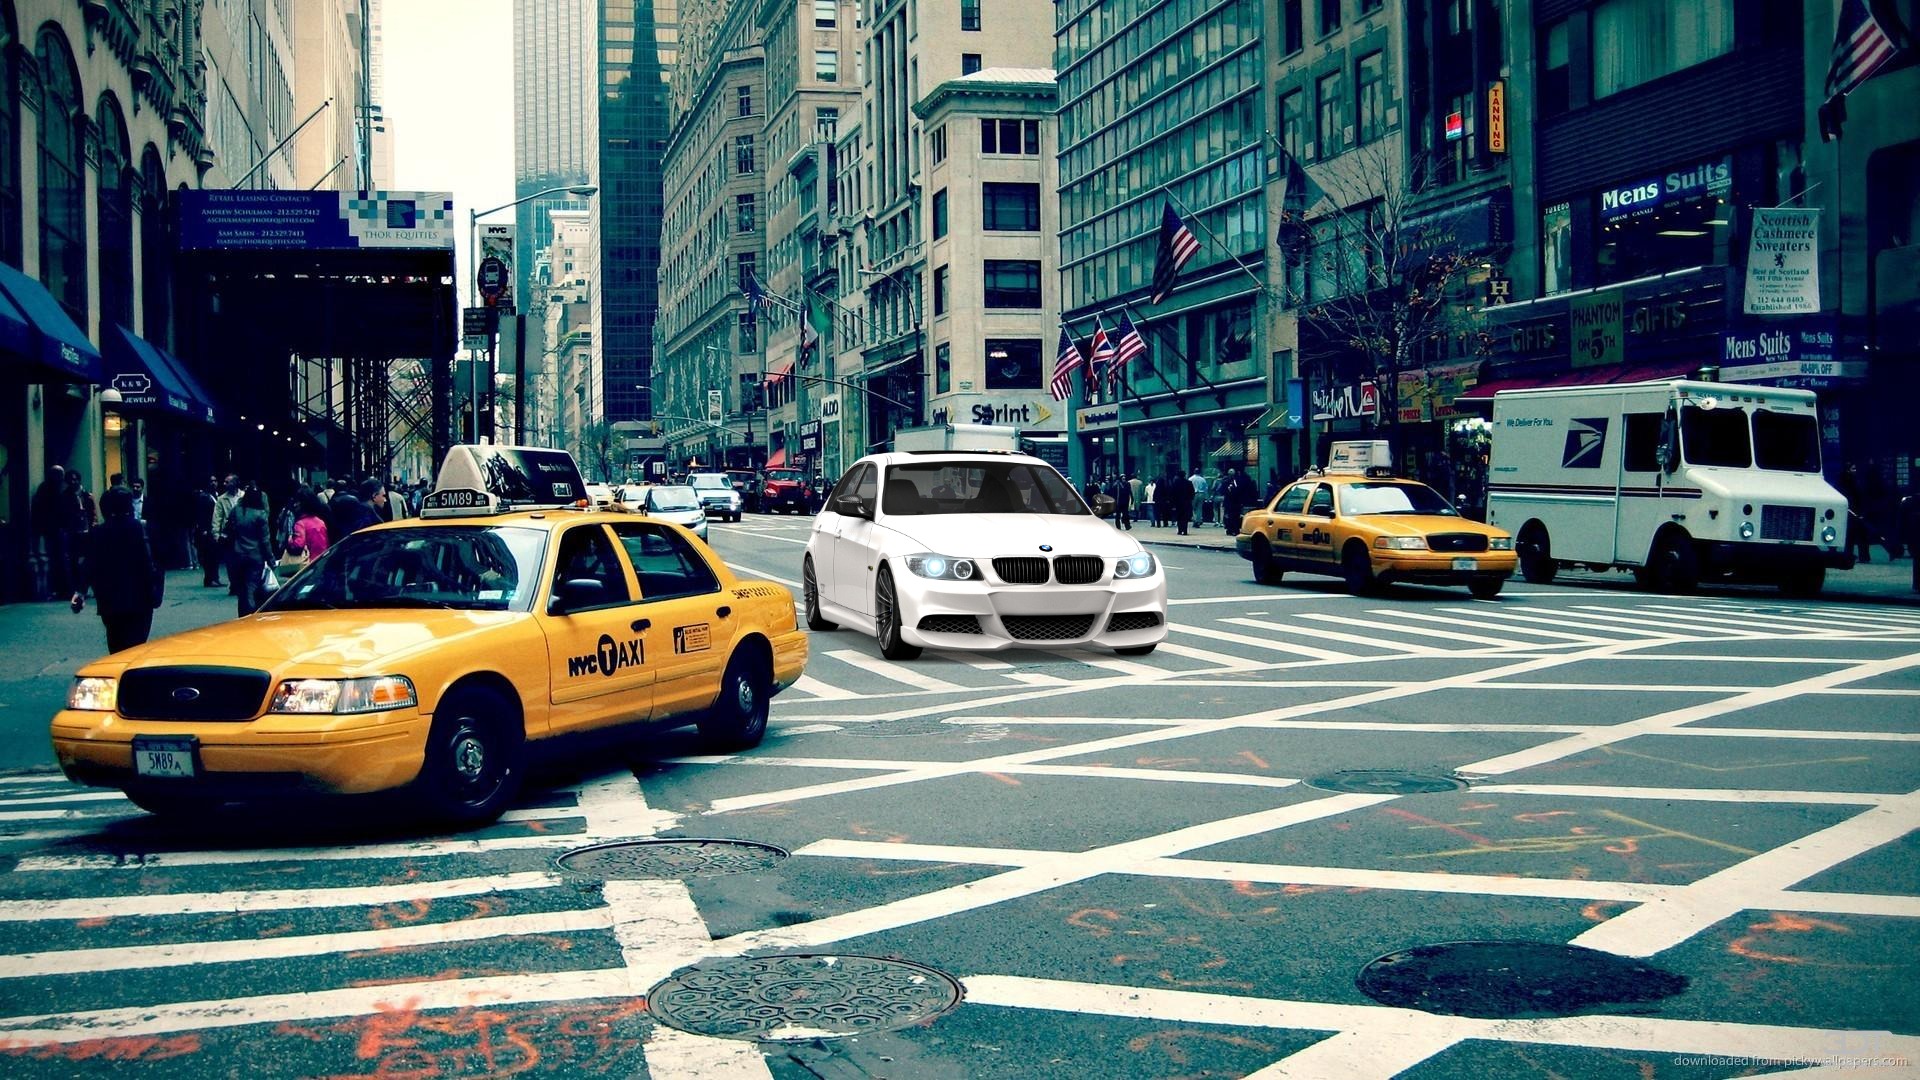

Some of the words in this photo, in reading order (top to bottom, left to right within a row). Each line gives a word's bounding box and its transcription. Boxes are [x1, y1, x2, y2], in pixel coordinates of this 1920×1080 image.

[1602, 182, 1659, 211] Mens
[1666, 163, 1728, 192] Suits
[208, 194, 234, 202] RETAIL
[237, 194, 267, 202] LEASING
[1545, 202, 1570, 215] TUXEDO
[1761, 214, 1809, 226] Scottish
[364, 231, 391, 239] THOR
[395, 231, 438, 240] EQUITIES
[1754, 227, 1815, 240] Cashmere
[1756, 240, 1810, 251] Sweaters
[1572, 303, 1620, 328] PHANTOM
[1632, 301, 1686, 336] GIFTS
[1510, 325, 1557, 352] GIFTS
[1801, 332, 1816, 343] Mens
[1817, 332, 1833, 344] Suits
[1578, 338, 1590, 352] ON
[1725, 336, 1756, 360] Mens
[1759, 330, 1791, 357] Suits
[1821, 364, 1832, 374] OFF
[823, 399, 839, 417] ALDO
[1506, 418, 1514, 428] We
[1515, 418, 1533, 427] Deliver
[1533, 418, 1542, 426] For
[441, 491, 472, 506] 5M89
[568, 654, 598, 677] NYC
[598, 636, 644, 675] TAXI
